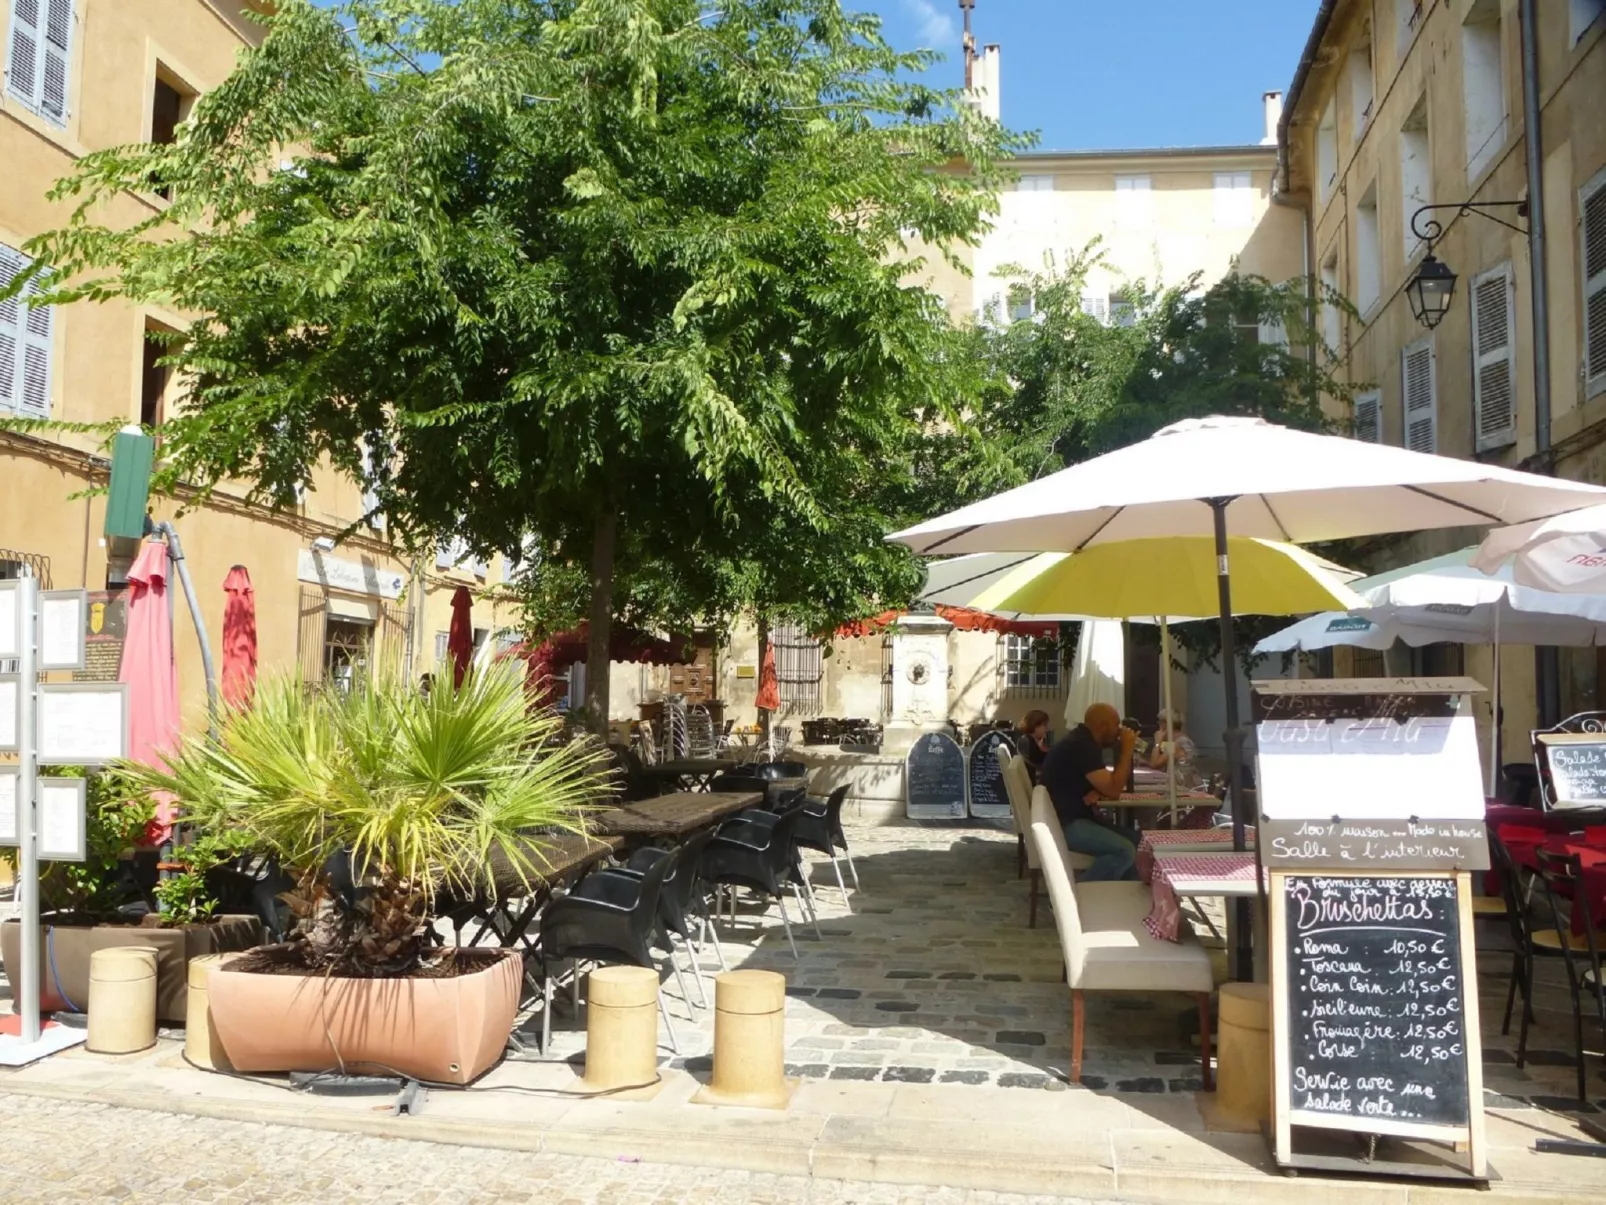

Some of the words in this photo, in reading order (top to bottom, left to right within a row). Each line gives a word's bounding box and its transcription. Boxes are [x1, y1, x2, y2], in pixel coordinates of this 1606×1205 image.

[1451, 824, 1483, 838] house
[1304, 937, 1349, 954] Roma
[1310, 975, 1344, 993] Coin
[1357, 1076, 1395, 1092] avec
